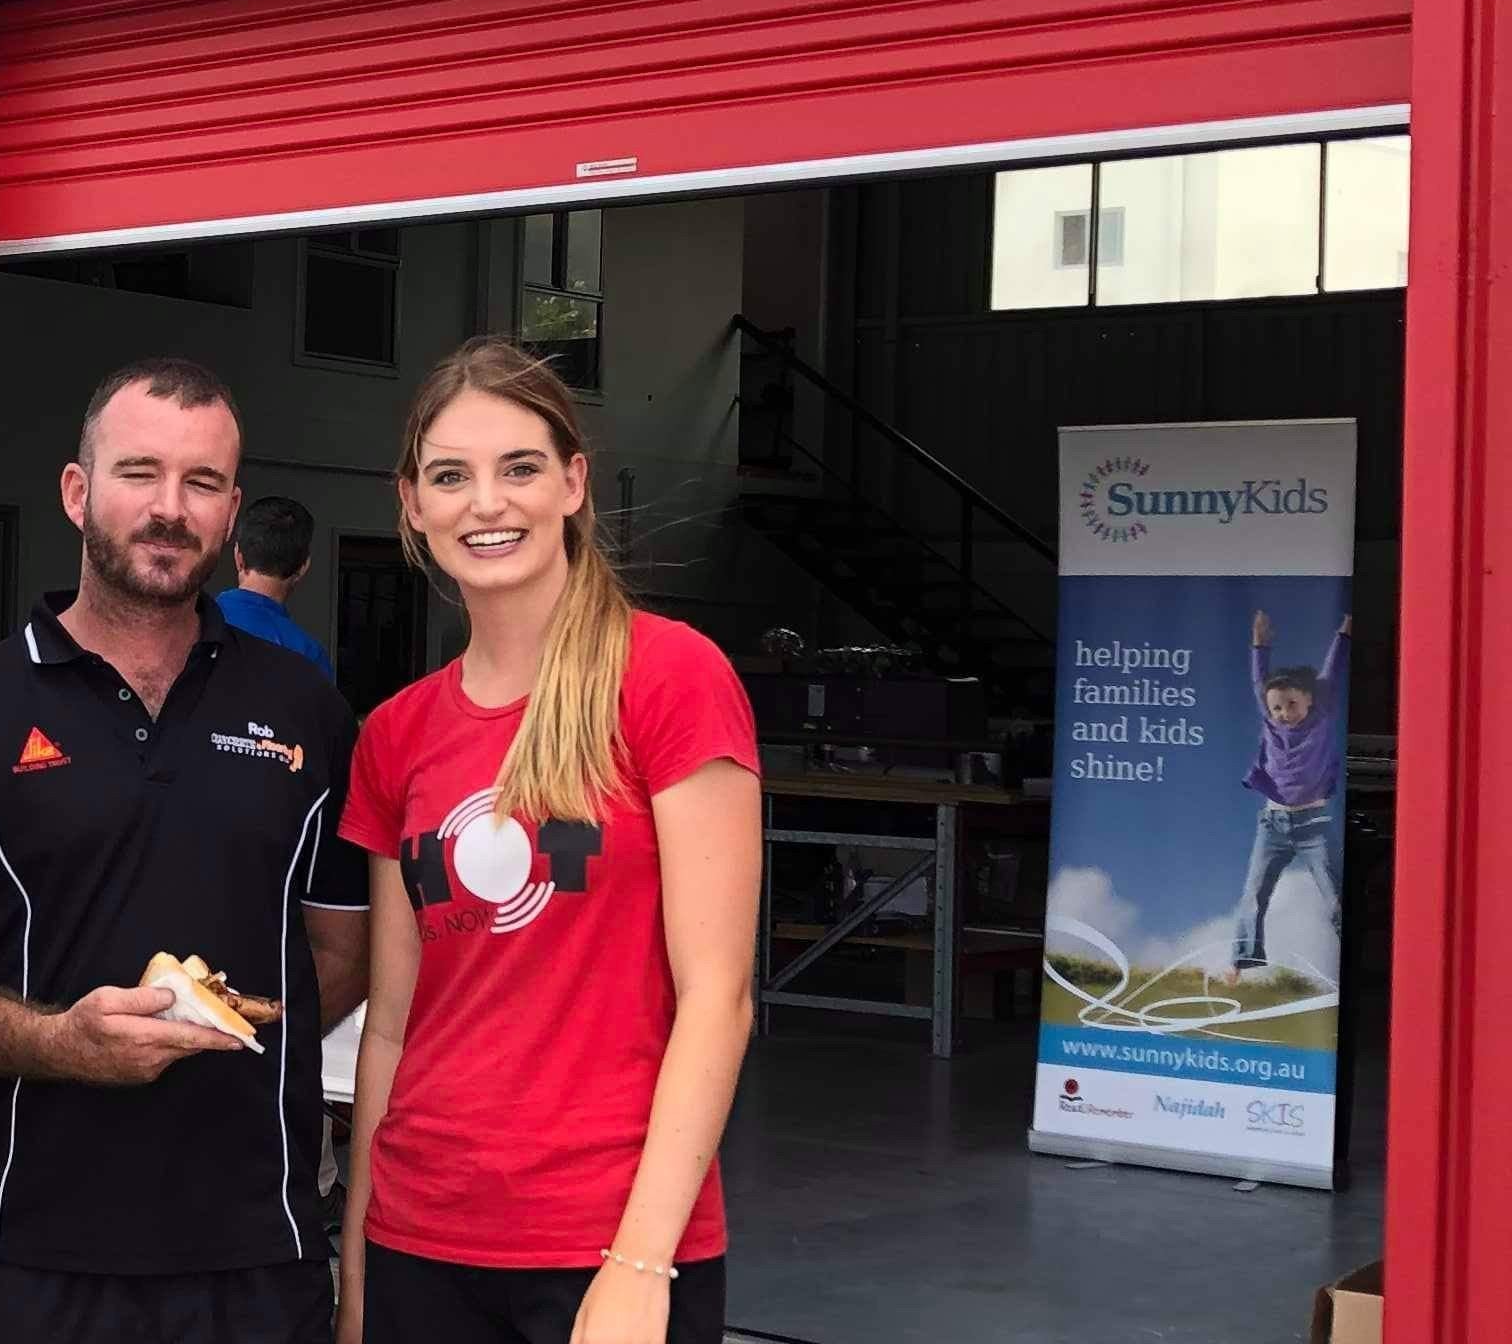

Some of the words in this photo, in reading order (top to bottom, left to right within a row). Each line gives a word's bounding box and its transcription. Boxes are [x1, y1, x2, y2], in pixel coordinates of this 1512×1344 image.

[1108, 478, 1328, 524] SunnyKids
[1075, 640, 1192, 675] helping
[1073, 677, 1196, 707] families
[248, 721, 274, 738] Rob
[1072, 716, 1129, 743] and
[1139, 716, 1204, 745] kids
[1070, 752, 1164, 782] shine!
[1061, 1038, 1306, 1080] www.sunnykids.org.au
[1153, 1094, 1226, 1120] Najidah
[1246, 1099, 1305, 1129] SKIS
